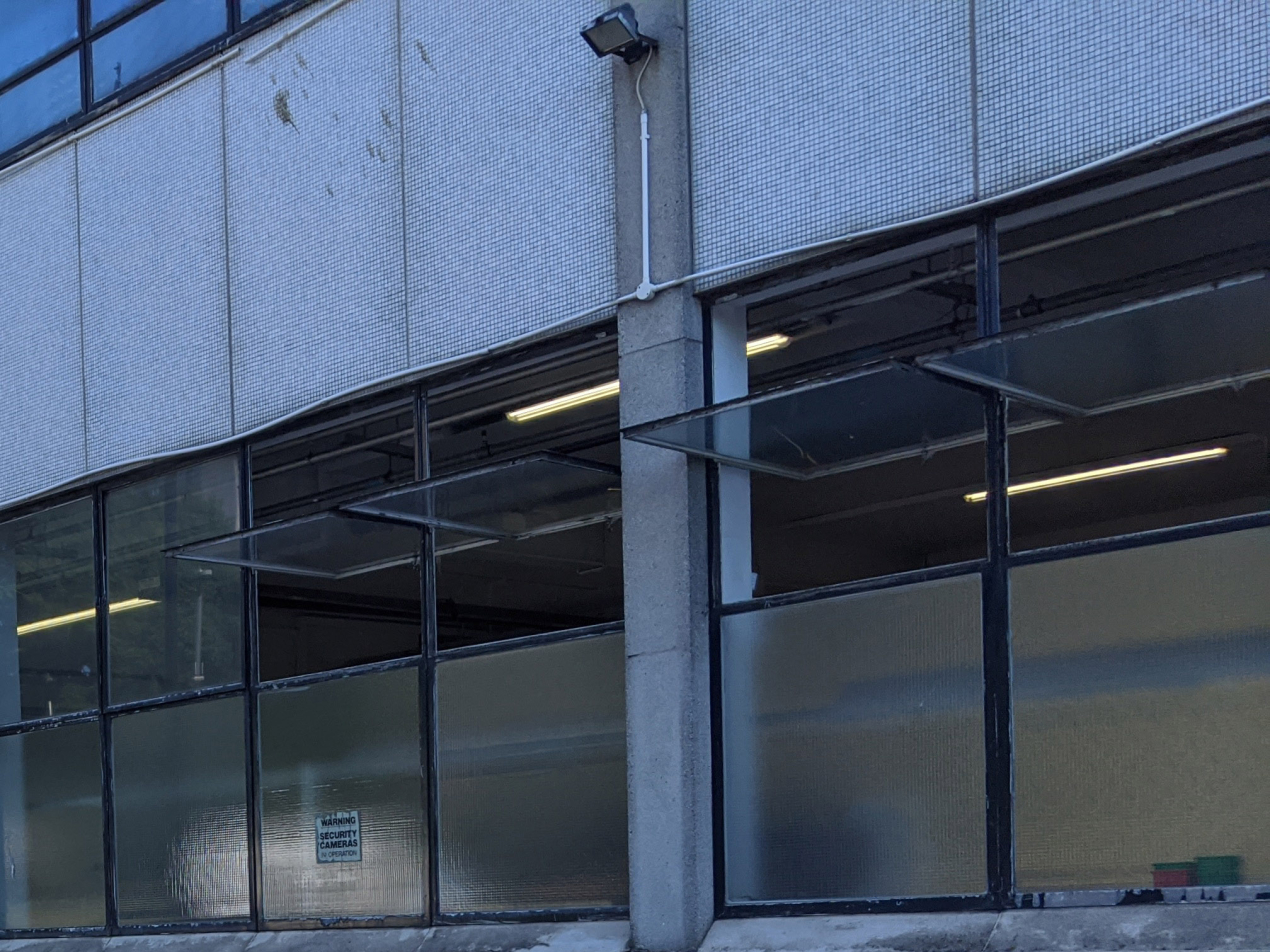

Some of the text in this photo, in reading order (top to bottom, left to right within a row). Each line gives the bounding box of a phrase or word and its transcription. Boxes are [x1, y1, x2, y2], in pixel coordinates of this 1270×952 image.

[320, 816, 356, 826] WARNING
[320, 830, 357, 840] SECURITY
[320, 839, 358, 850] CAMERAS
[328, 850, 358, 858] OPERATION
